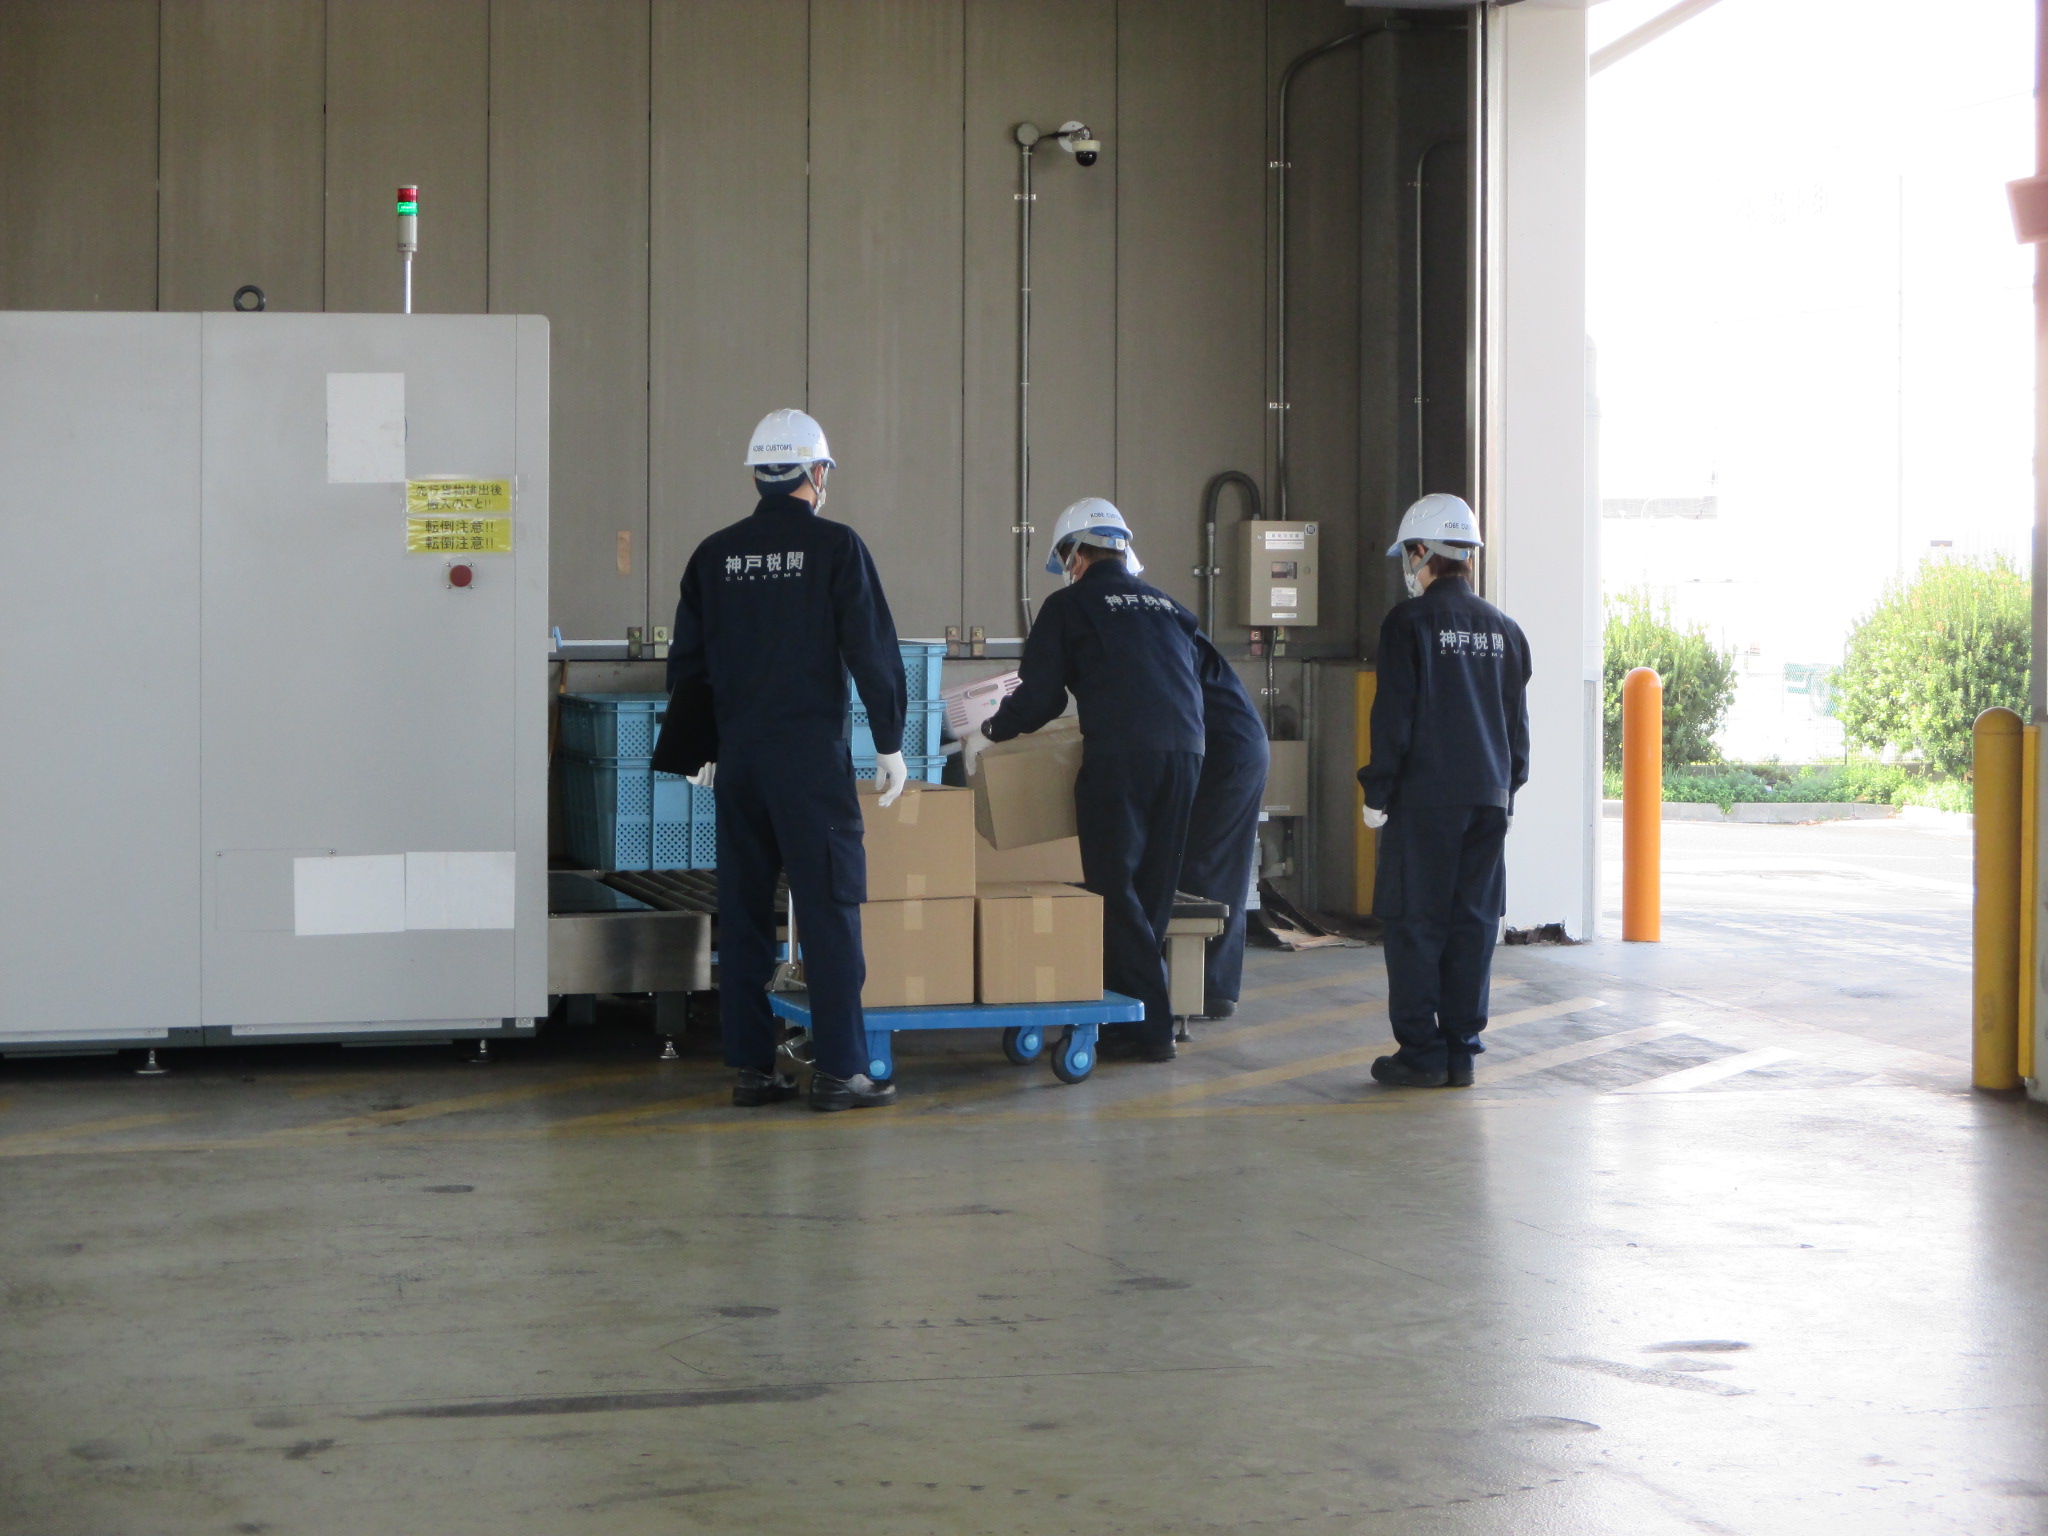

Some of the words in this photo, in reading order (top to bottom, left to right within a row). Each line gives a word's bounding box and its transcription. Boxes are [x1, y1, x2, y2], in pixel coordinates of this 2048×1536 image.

[766, 444, 793, 452] CUSTOMS
[416, 484, 502, 496] 先行貨物排出後
[425, 520, 494, 533] 転倒注意!!
[425, 536, 494, 550] 転倒注意!!
[725, 551, 805, 574] 神戸税関
[726, 572, 802, 582] CUSTOMS
[1439, 629, 1504, 651] 神戸税関
[1440, 649, 1504, 658] CUSTOMS
